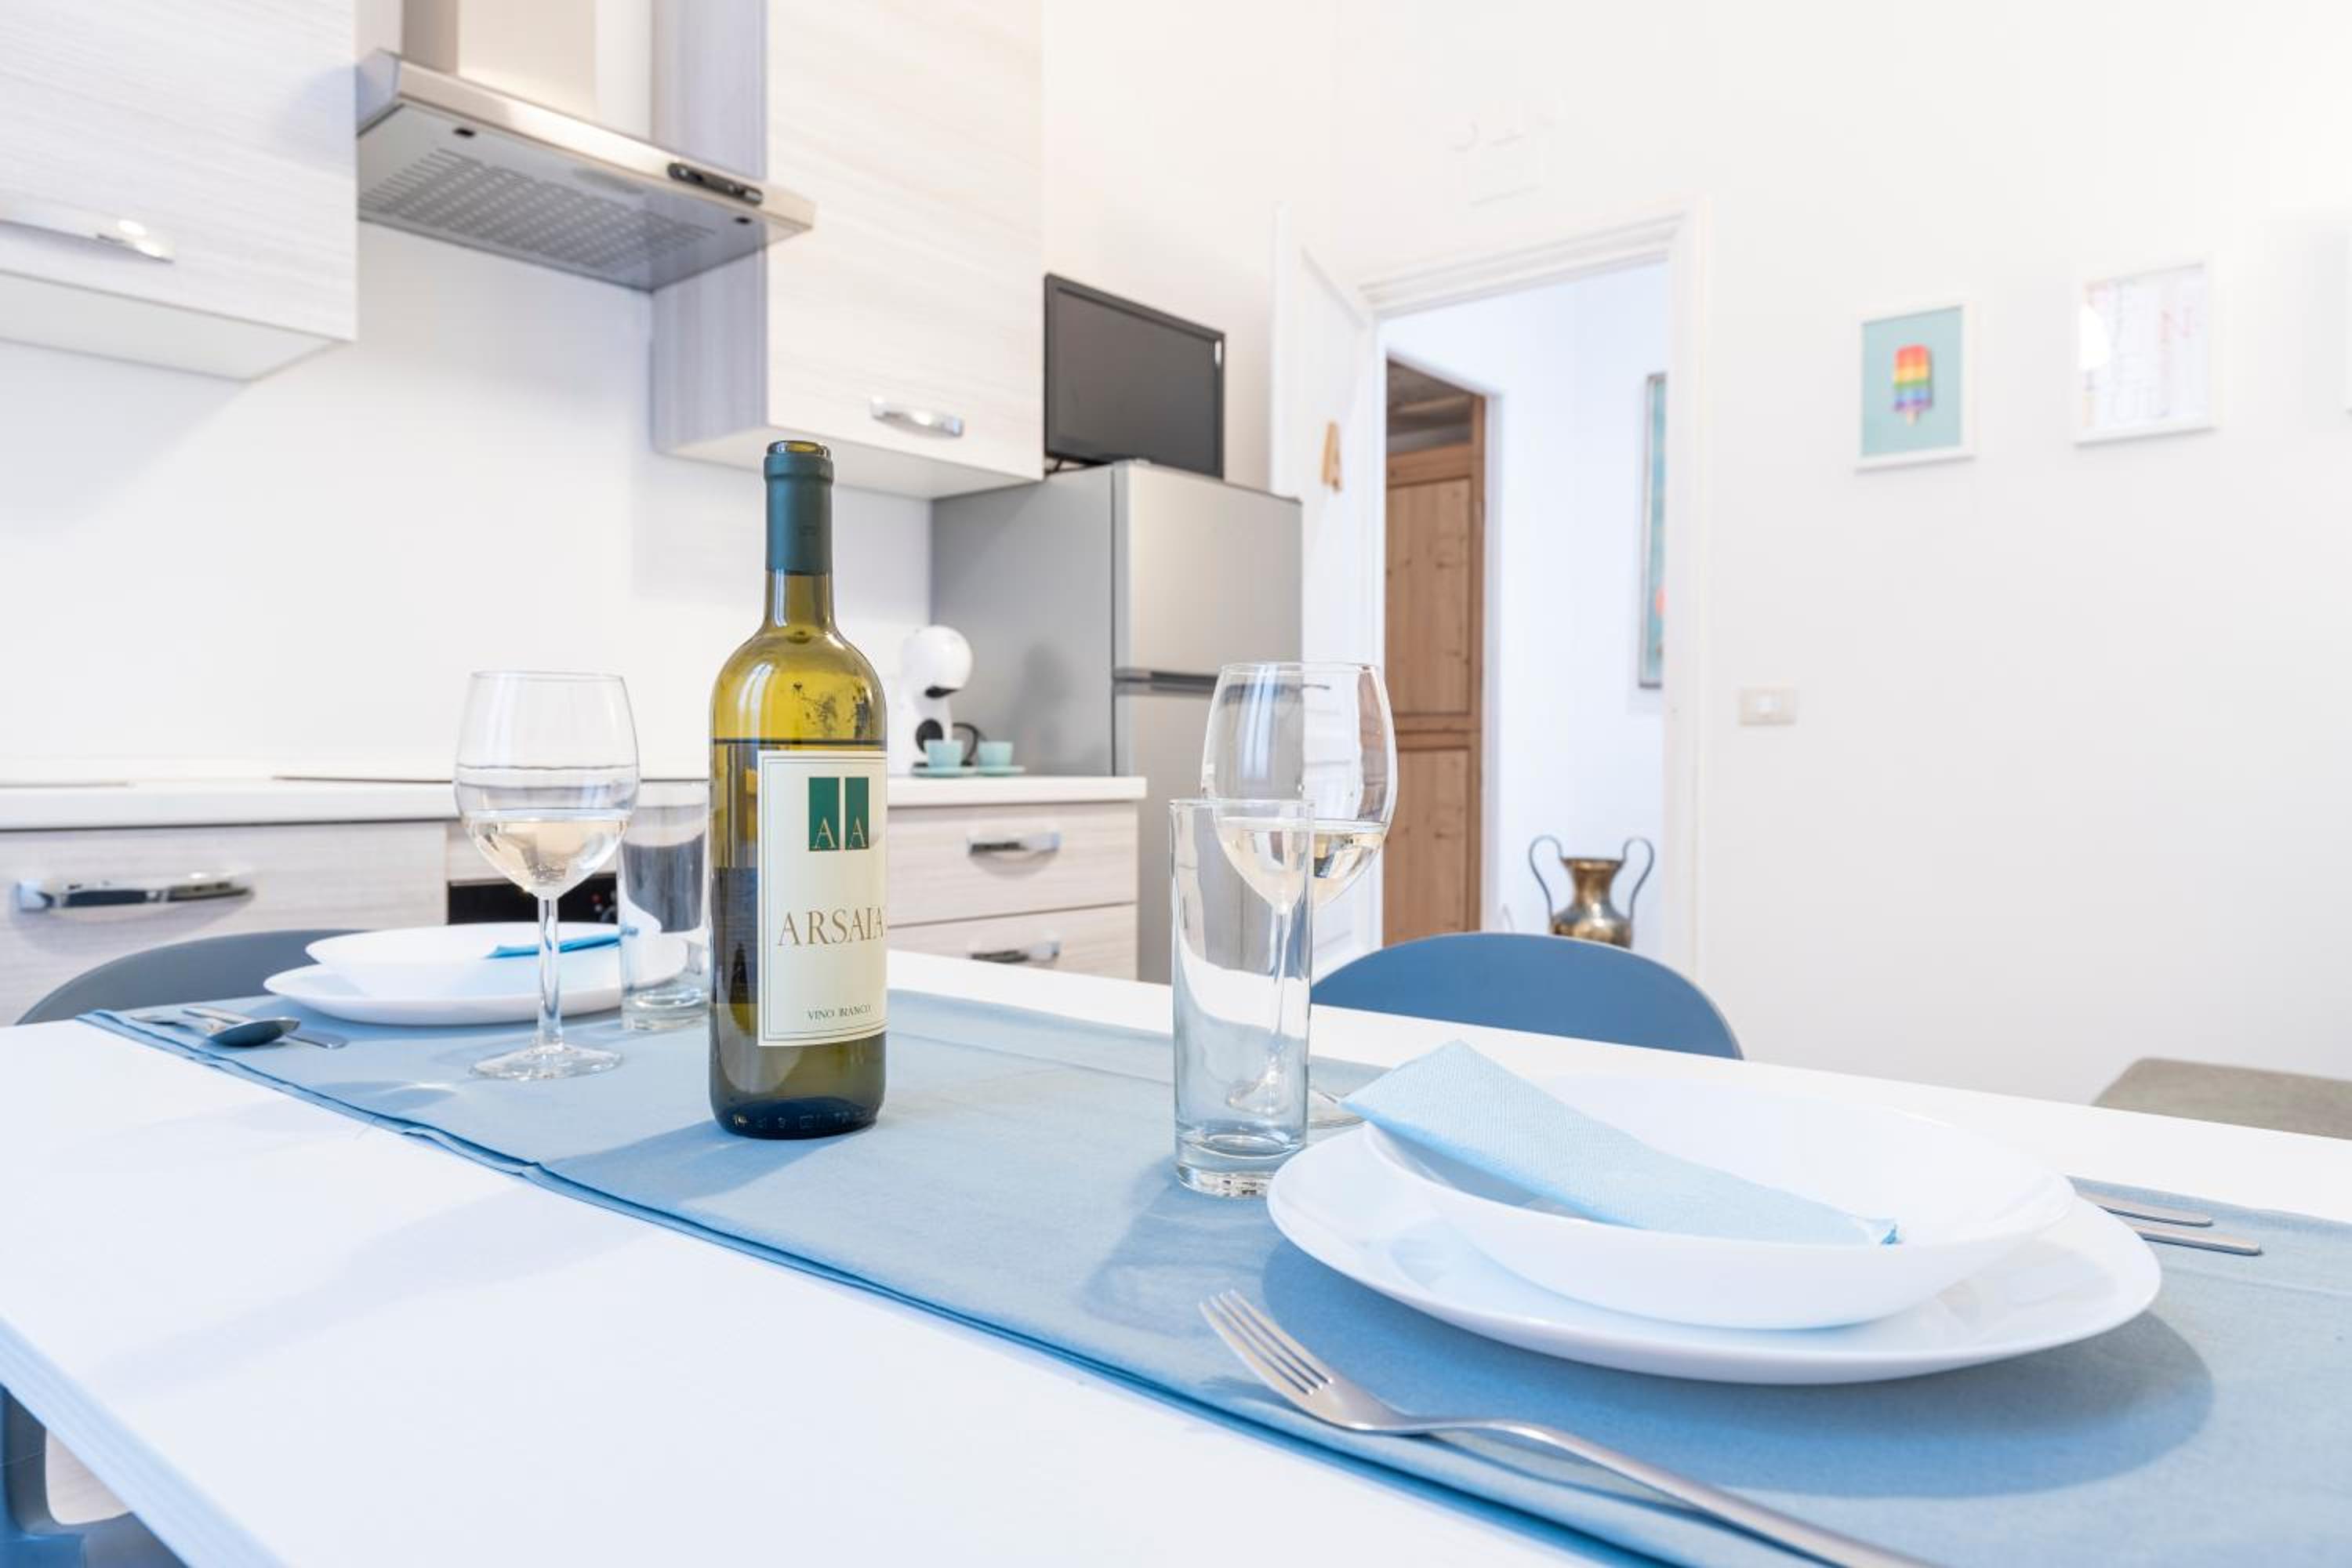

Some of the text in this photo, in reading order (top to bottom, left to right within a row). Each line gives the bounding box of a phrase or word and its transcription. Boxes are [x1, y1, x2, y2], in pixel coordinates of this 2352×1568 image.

[811, 816, 866, 849] A A
[778, 905, 884, 946] ARSAIA
[807, 1004, 872, 1020] VINO BIANCO
